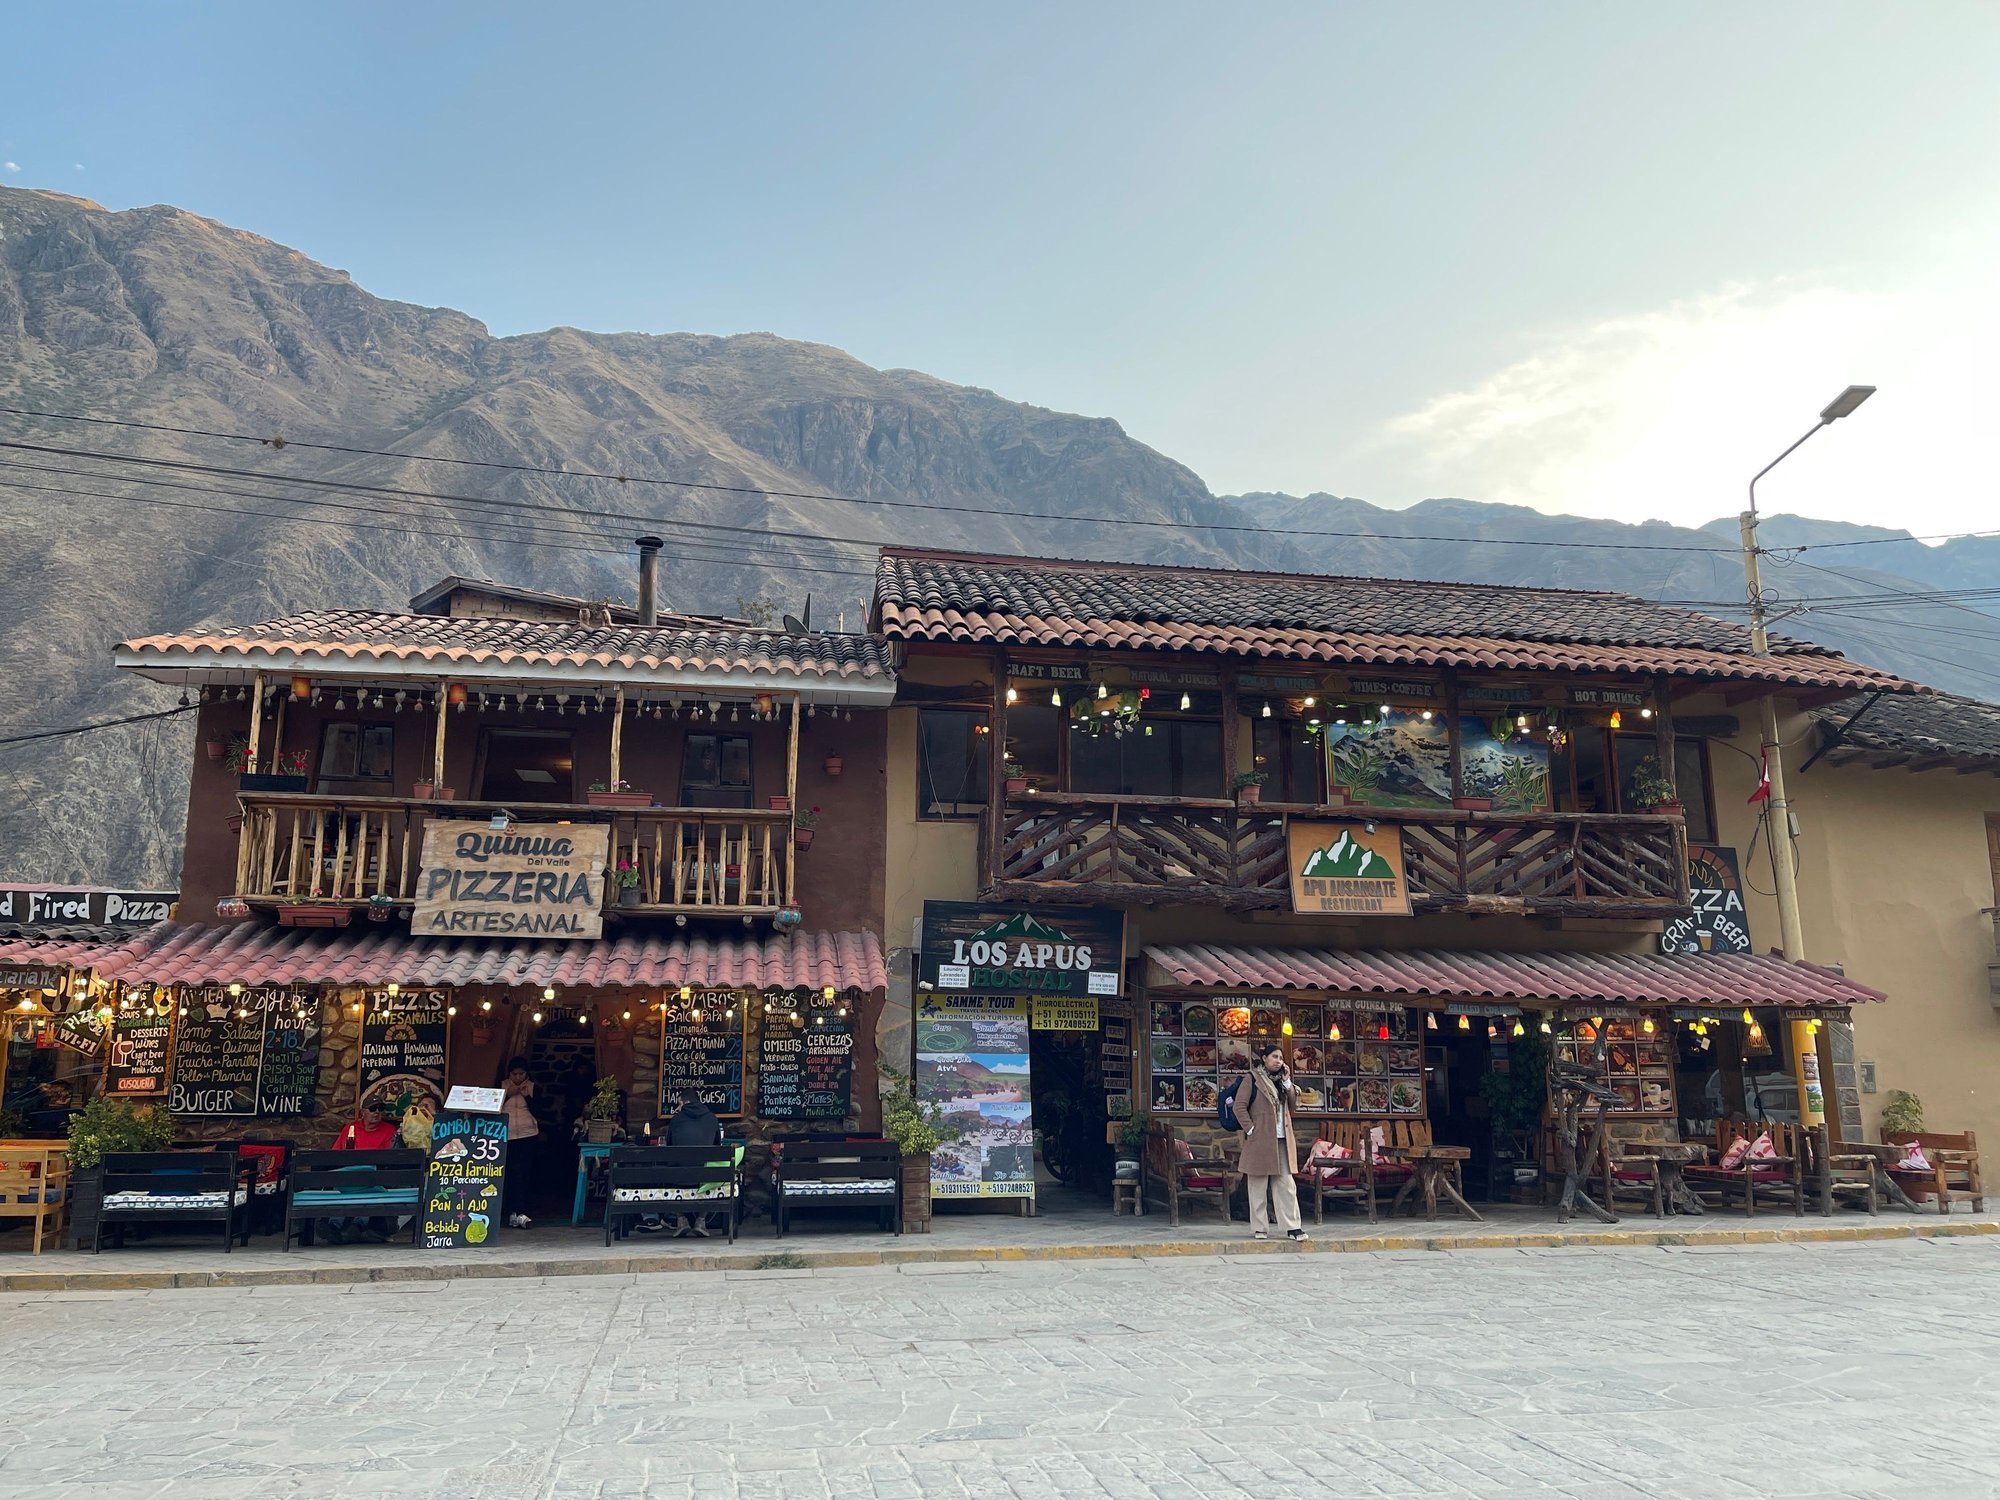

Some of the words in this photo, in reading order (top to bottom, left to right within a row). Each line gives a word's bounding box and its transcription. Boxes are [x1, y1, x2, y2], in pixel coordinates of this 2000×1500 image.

[1007, 663, 1044, 678] CRAFT
[1051, 665, 1082, 679] BEER
[1574, 690, 1598, 703] HOT
[1602, 692, 1642, 706] DRINKS
[455, 832, 574, 862] Quinua
[527, 857, 543, 866] Del
[546, 858, 570, 867] Valle
[425, 868, 594, 905] PIZZERIA
[1303, 879, 1327, 896] APU
[28, 892, 91, 923] Fired
[1690, 889, 1743, 911] ZZA
[428, 910, 586, 934] ARTESANAL
[1713, 914, 1749, 951] BEER
[951, 939, 1008, 967] LOS
[1013, 942, 1092, 971] APUS
[971, 967, 1073, 991] HOSTAL
[373, 991, 445, 1011] PIZZS
[946, 995, 984, 1008] SAMME
[988, 996, 1016, 1009] TOUR
[1212, 997, 1248, 1007] GRILLED
[1251, 998, 1282, 1010] ALPACA
[1329, 999, 1351, 1009] OVEN
[1354, 1000, 1386, 1011] GUINEA
[1389, 1002, 1403, 1012] PIG
[274, 1014, 311, 1030] hour
[366, 1011, 446, 1026] ARTESANALES
[765, 1015, 792, 1023] PAPAYA
[1035, 1009, 1052, 1019] +51
[1057, 1010, 1096, 1020] 931155112
[177, 1020, 213, 1039] Lomo
[219, 1022, 262, 1039] Saltado
[1035, 1019, 1052, 1029] +51
[130, 1027, 168, 1038] DESSERTS
[59, 1028, 97, 1053] WI-FI
[222, 1041, 261, 1053] Quinua
[763, 1039, 802, 1052] OMELETS
[807, 1034, 853, 1047] CERVEZAS
[176, 1055, 213, 1068] Trucha
[221, 1055, 259, 1068] Parrilla
[176, 1069, 203, 1082] Pollo
[211, 1069, 252, 1082] Plancha
[662, 1089, 726, 1104] HAGUESA
[431, 1118, 471, 1141] COMBO
[475, 1118, 508, 1143] PIZZA
[471, 1138, 500, 1161] 35
[429, 1161, 463, 1177] Pizza
[465, 1160, 505, 1177] familiar
[439, 1177, 449, 1185] 10
[452, 1176, 489, 1185] Porciones
[935, 1183, 980, 1194] +51931155112
[456, 1199, 464, 1211] al
[425, 1219, 460, 1234] Bebida
[426, 1235, 453, 1249] Jarra
